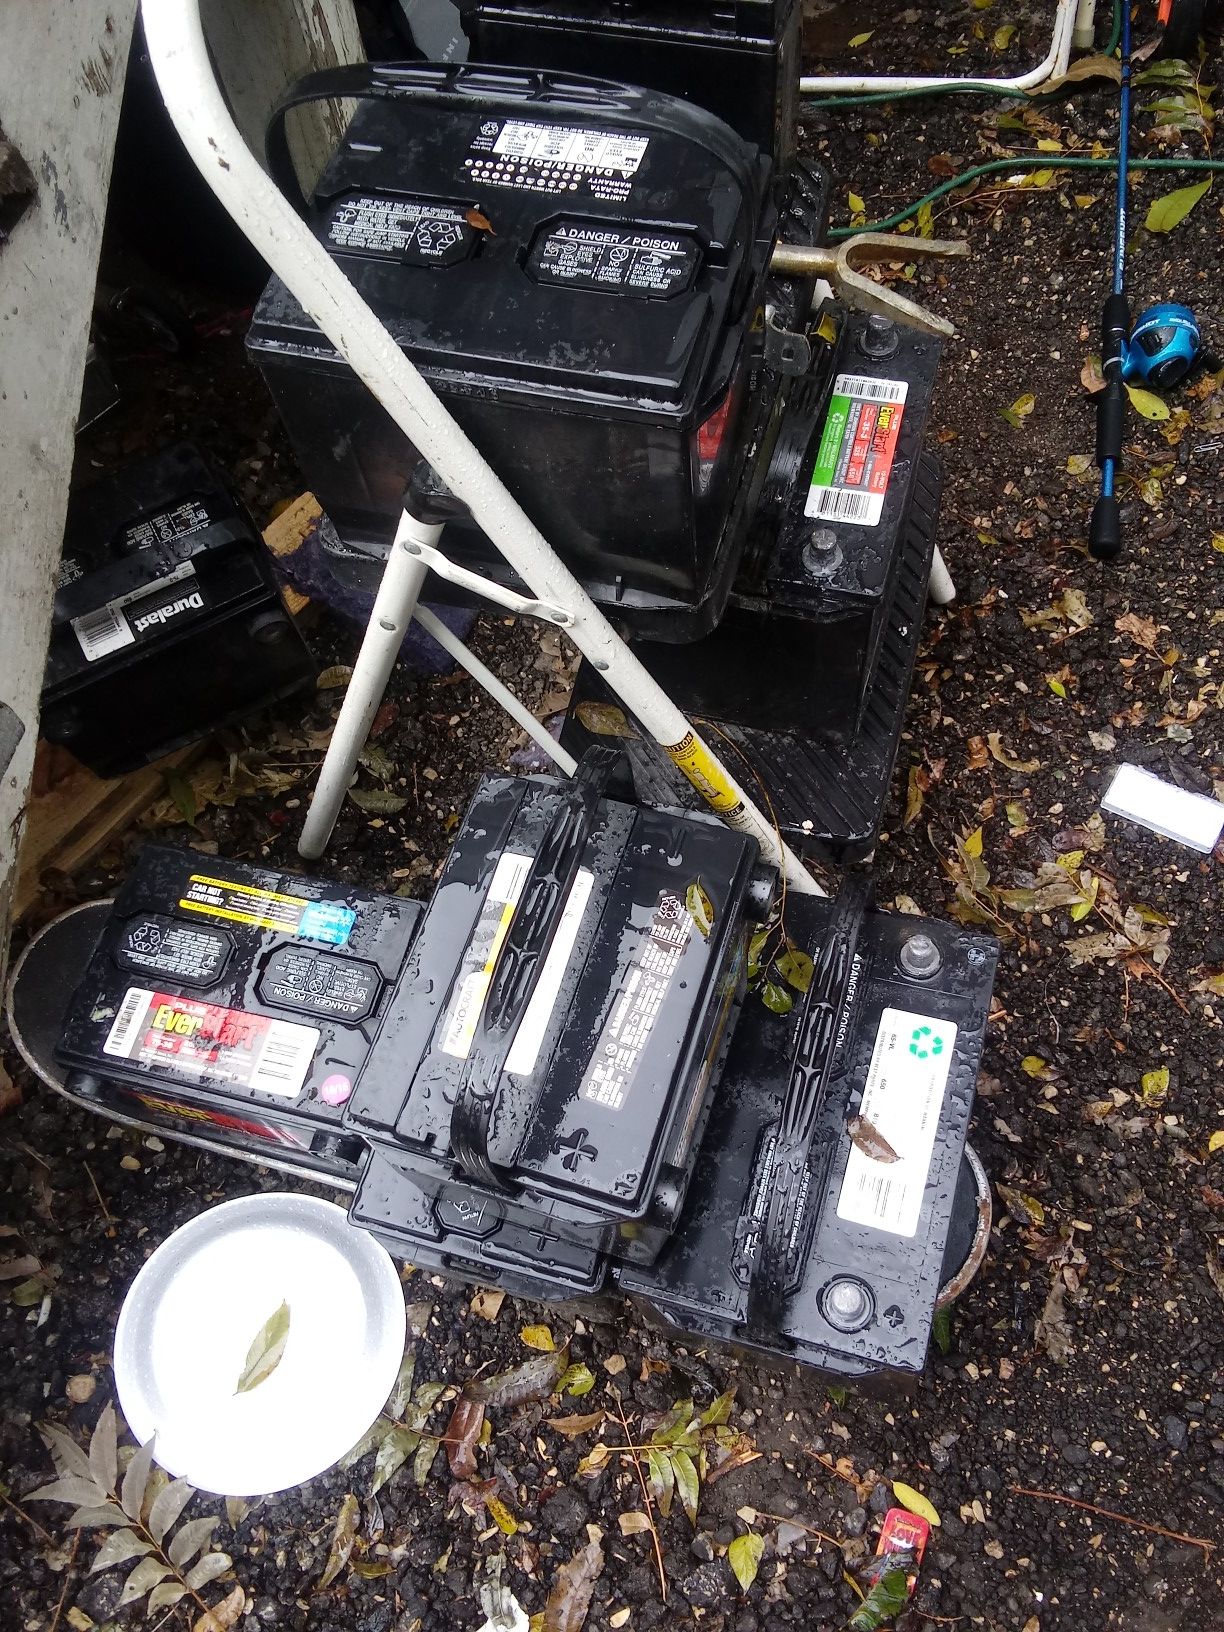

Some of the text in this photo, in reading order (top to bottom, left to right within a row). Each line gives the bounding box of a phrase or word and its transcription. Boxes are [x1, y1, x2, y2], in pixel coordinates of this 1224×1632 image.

[587, 177, 631, 188] WARRANTY
[590, 184, 629, 195] PRO-RATA
[594, 192, 626, 201] LIMITED
[569, 229, 619, 244] DANGER
[633, 237, 679, 250] POISON
[666, 267, 681, 276] ACID
[870, 404, 895, 454] EverStart
[133, 591, 204, 633] Duralast
[191, 882, 222, 896] CAR NOT
[185, 890, 225, 905] STARTING?
[272, 986, 306, 1001] POISON
[174, 1001, 207, 1015] PLUS
[313, 996, 350, 1011] DANGER
[150, 1001, 258, 1053] EverStart
